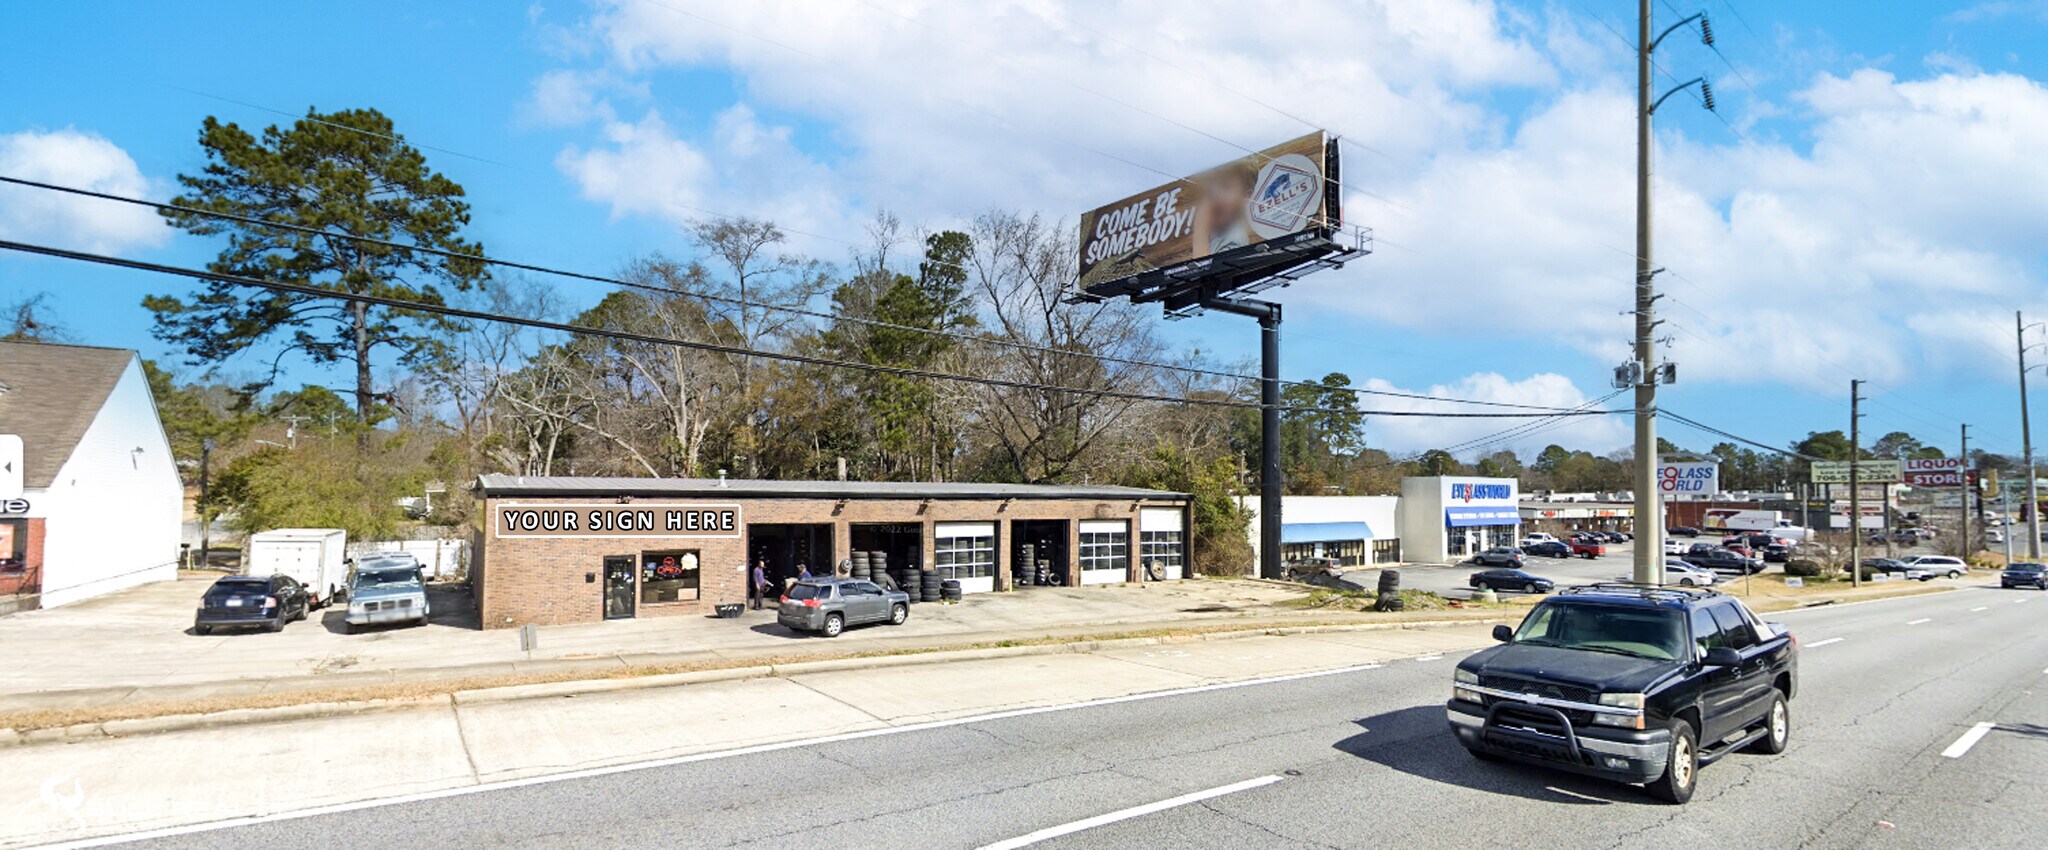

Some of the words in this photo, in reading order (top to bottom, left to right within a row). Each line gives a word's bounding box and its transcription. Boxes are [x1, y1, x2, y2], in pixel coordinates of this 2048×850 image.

[1096, 198, 1150, 239] COME
[1153, 187, 1181, 220] BE
[1258, 182, 1308, 213] EZELL'S
[1085, 206, 1197, 265] SOMEBODY!
